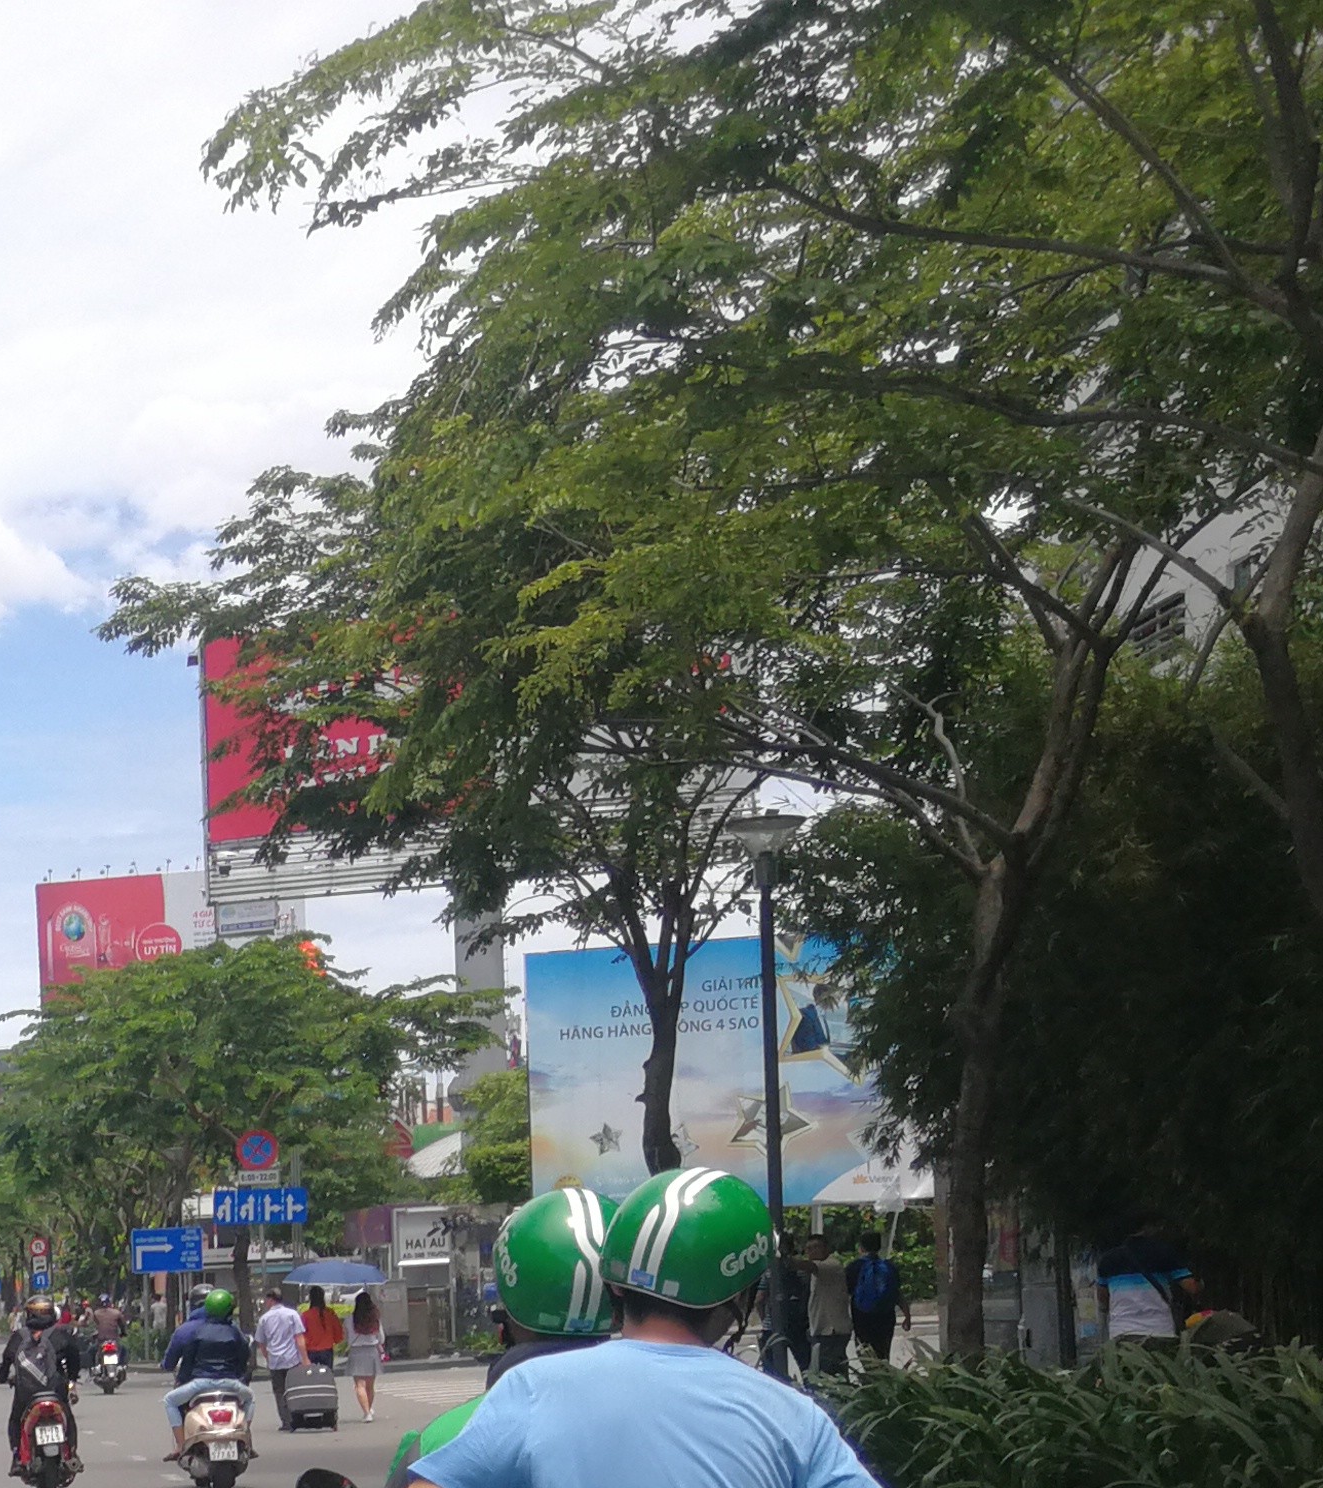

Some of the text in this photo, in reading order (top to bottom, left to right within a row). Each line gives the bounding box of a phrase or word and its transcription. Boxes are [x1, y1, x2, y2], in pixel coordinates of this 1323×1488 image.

[144, 942, 176, 955] UY TÍN
[702, 977, 732, 992] GIẢI
[693, 994, 739, 1013] QUỐC
[742, 993, 758, 1009] TẾ
[559, 1016, 759, 1041] HÃNG HÀNG ÔNG 4 SAO
[405, 1238, 426, 1249] HAI
[720, 1232, 768, 1277] Grab
